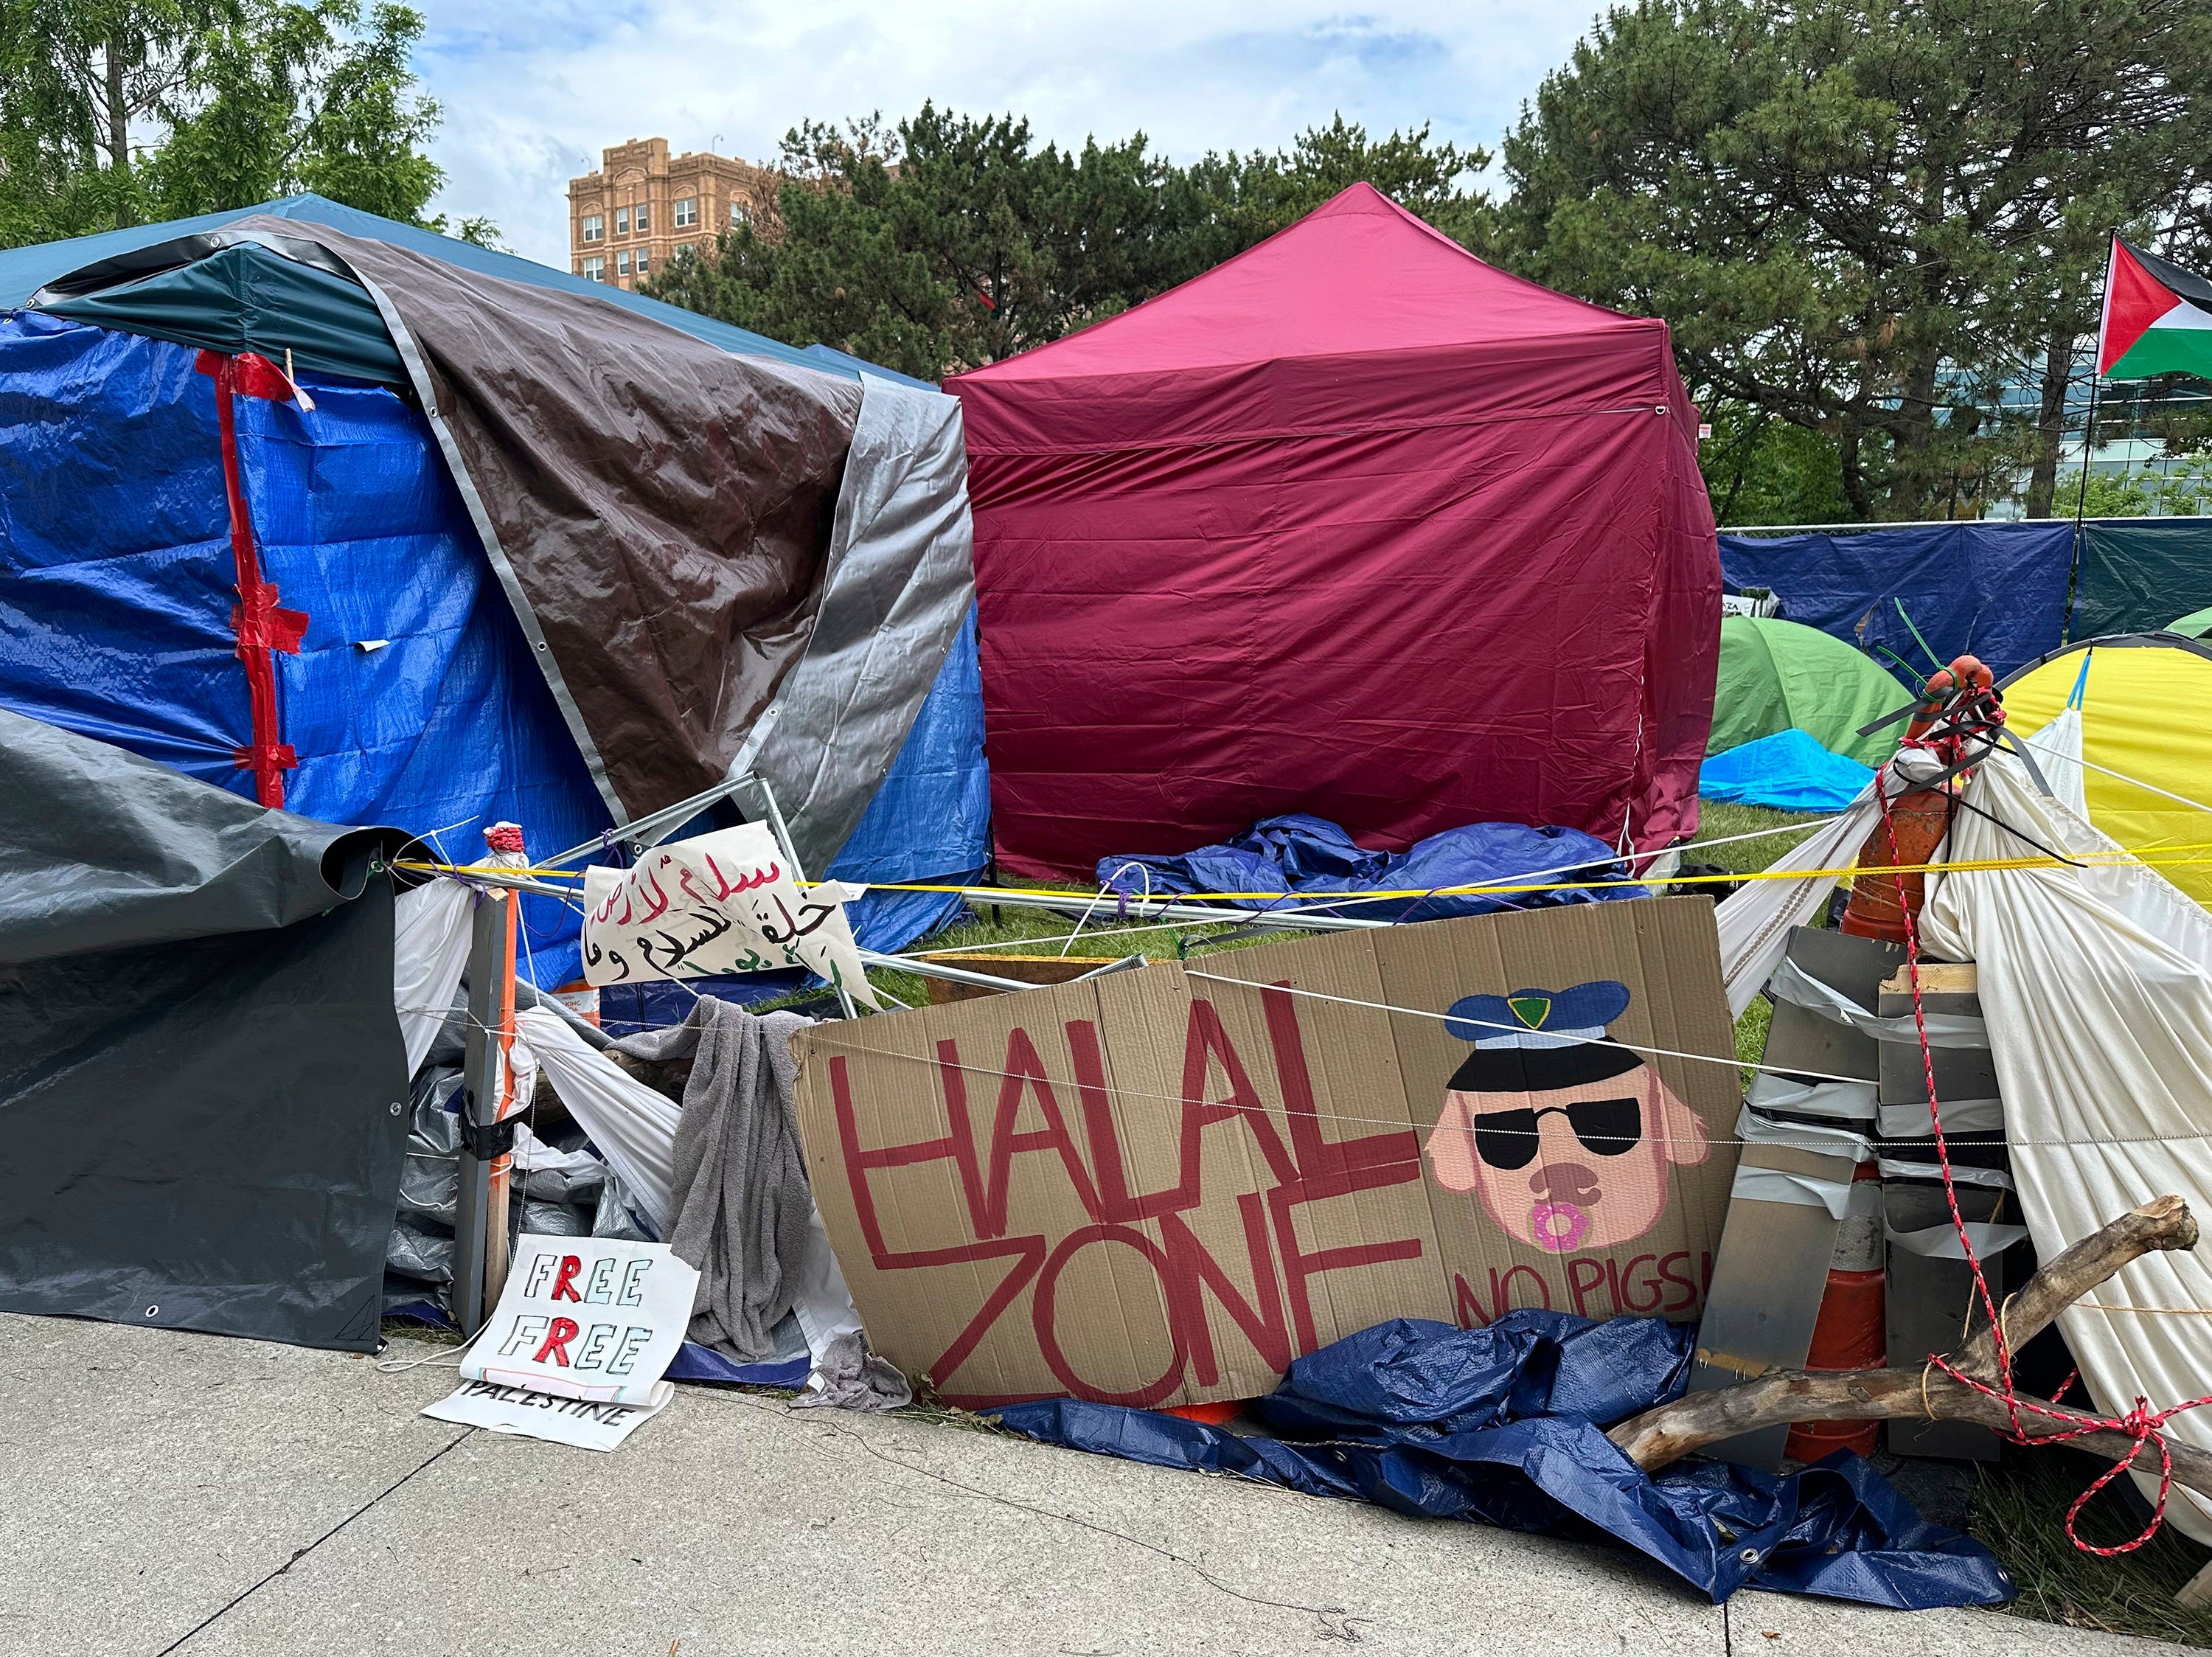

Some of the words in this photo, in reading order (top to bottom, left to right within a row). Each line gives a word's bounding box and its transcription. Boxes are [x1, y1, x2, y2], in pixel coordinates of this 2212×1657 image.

[830, 980, 1419, 1255] HALAL
[524, 1254, 653, 1307] FREE
[1454, 1264, 1551, 1330] NO
[497, 1315, 653, 1375] FREE
